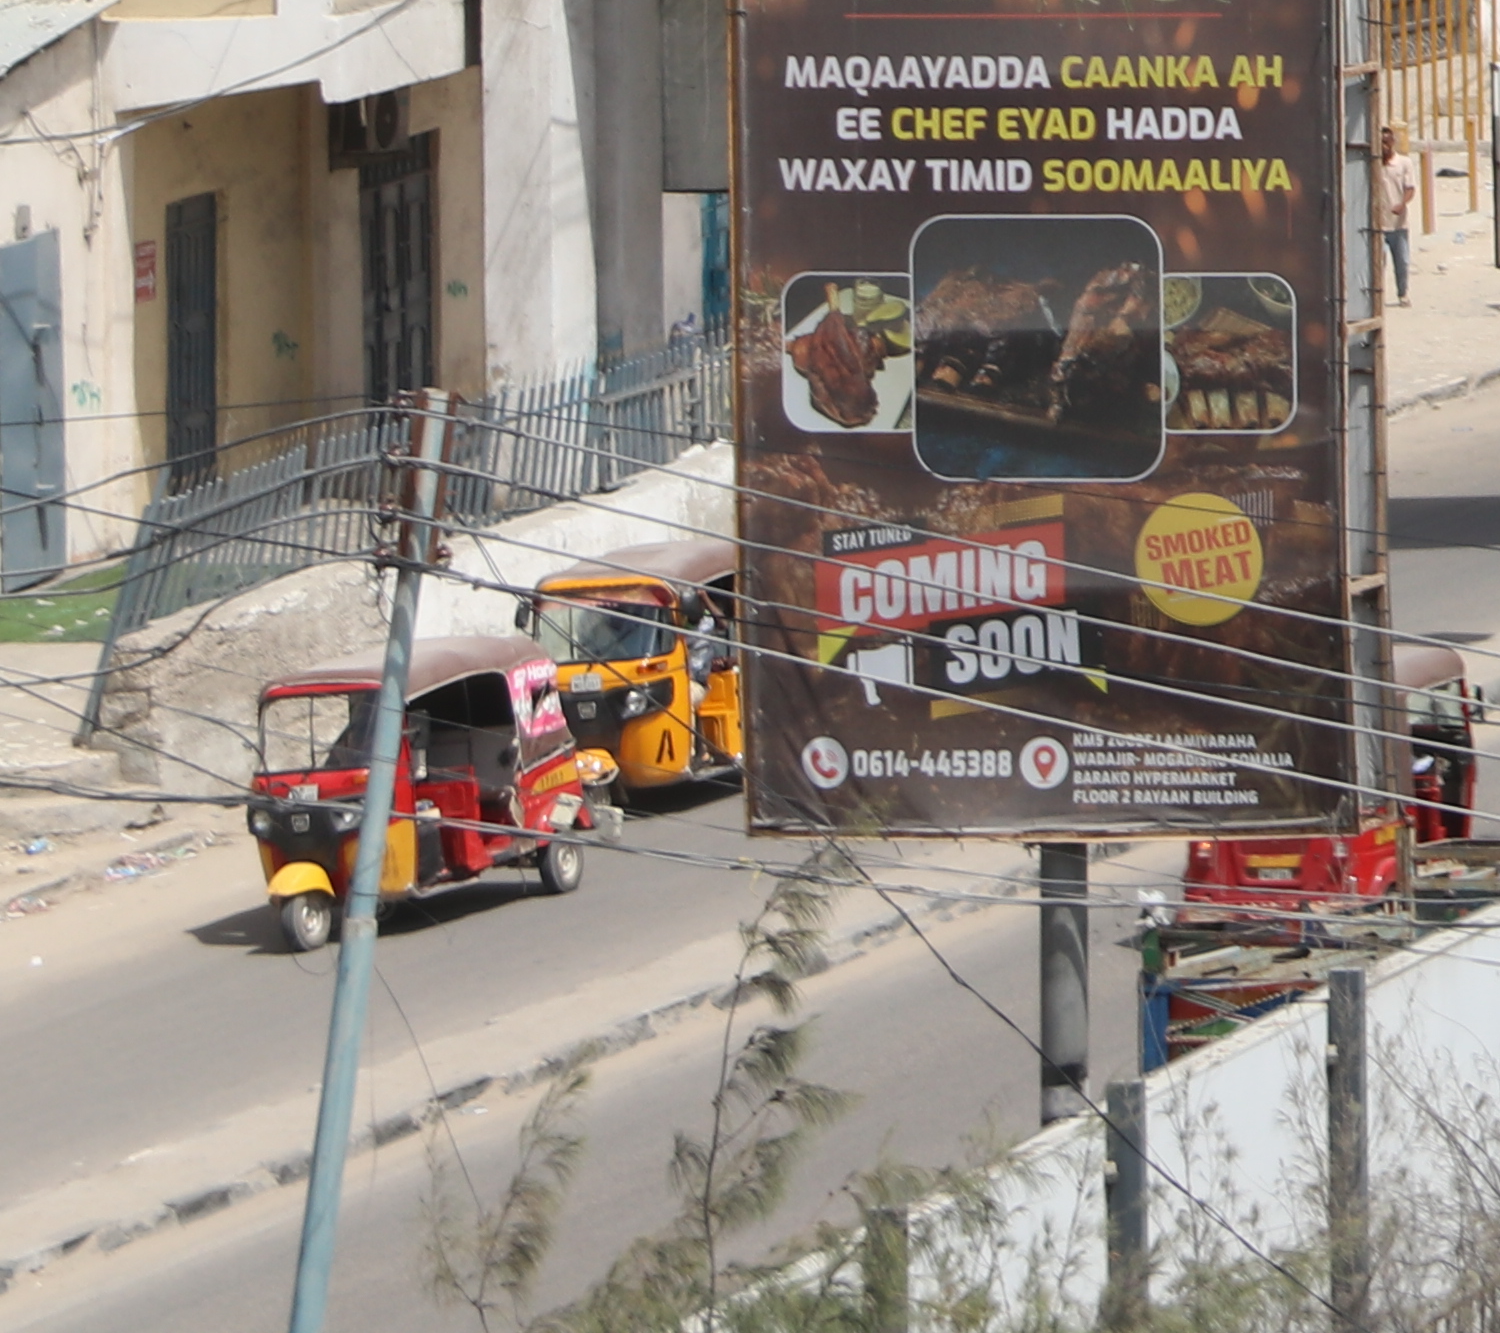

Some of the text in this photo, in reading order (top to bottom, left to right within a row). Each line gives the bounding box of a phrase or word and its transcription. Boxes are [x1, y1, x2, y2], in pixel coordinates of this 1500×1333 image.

[784, 54, 1284, 97] MAQAAYADDA CAANKA AH
[835, 106, 1243, 141] EE CHEF EYAD HADDA
[778, 157, 1293, 192] WAXAY TIMID SOOMAALIYA
[832, 525, 913, 552] STAY TUNED
[1144, 519, 1252, 562] SMOKED
[839, 539, 1049, 624] COMING
[1160, 549, 1253, 595] MEAT
[945, 609, 1082, 684] SOON
[852, 749, 1013, 779] 0614-445388
[1072, 770, 1238, 787] BARAKO HYPERMARKET
[1072, 789, 1259, 805] FLOOR 2 RAYAAN BUILDING
